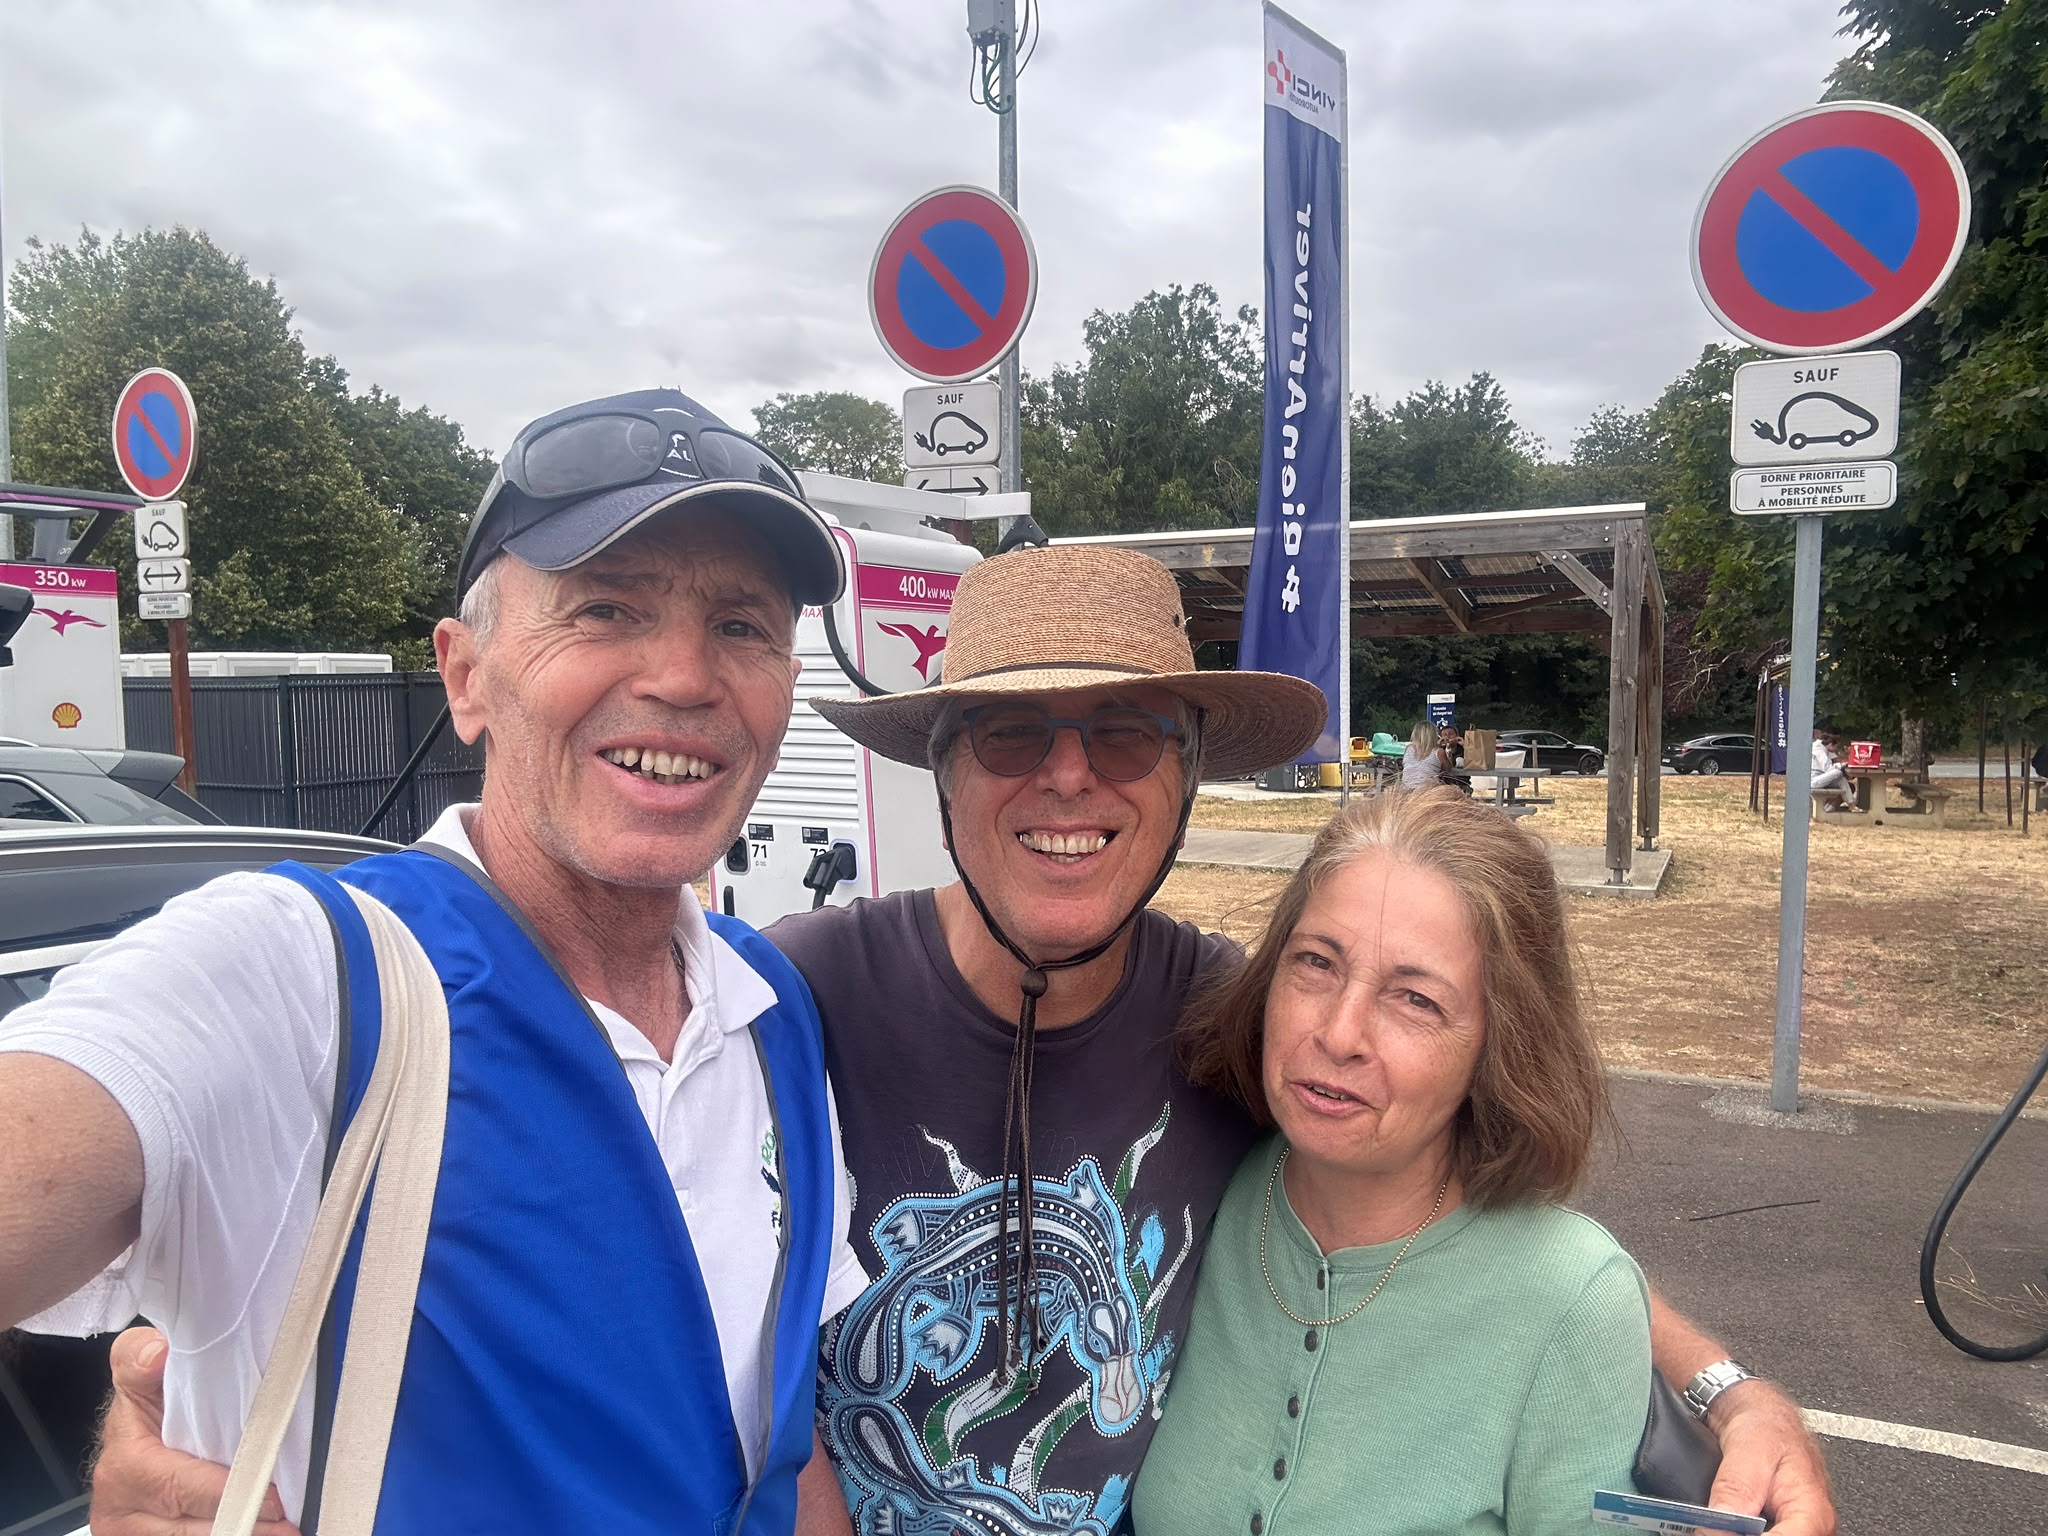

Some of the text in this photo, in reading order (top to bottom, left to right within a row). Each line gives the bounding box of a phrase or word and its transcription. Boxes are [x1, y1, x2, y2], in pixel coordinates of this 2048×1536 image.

[1793, 367, 1840, 384] SAUF
[937, 393, 964, 405] SAUF
[1760, 469, 1866, 483] BORNE PRIORITAIRE
[1780, 485, 1843, 496] PERSONNES
[1758, 493, 1866, 508] À MOBILITÉ RÉDUITE
[151, 509, 166, 517] SAUF
[34, 570, 87, 588] 350 kW
[898, 575, 956, 600] 400 kW MAX
[751, 844, 768, 858] 71
